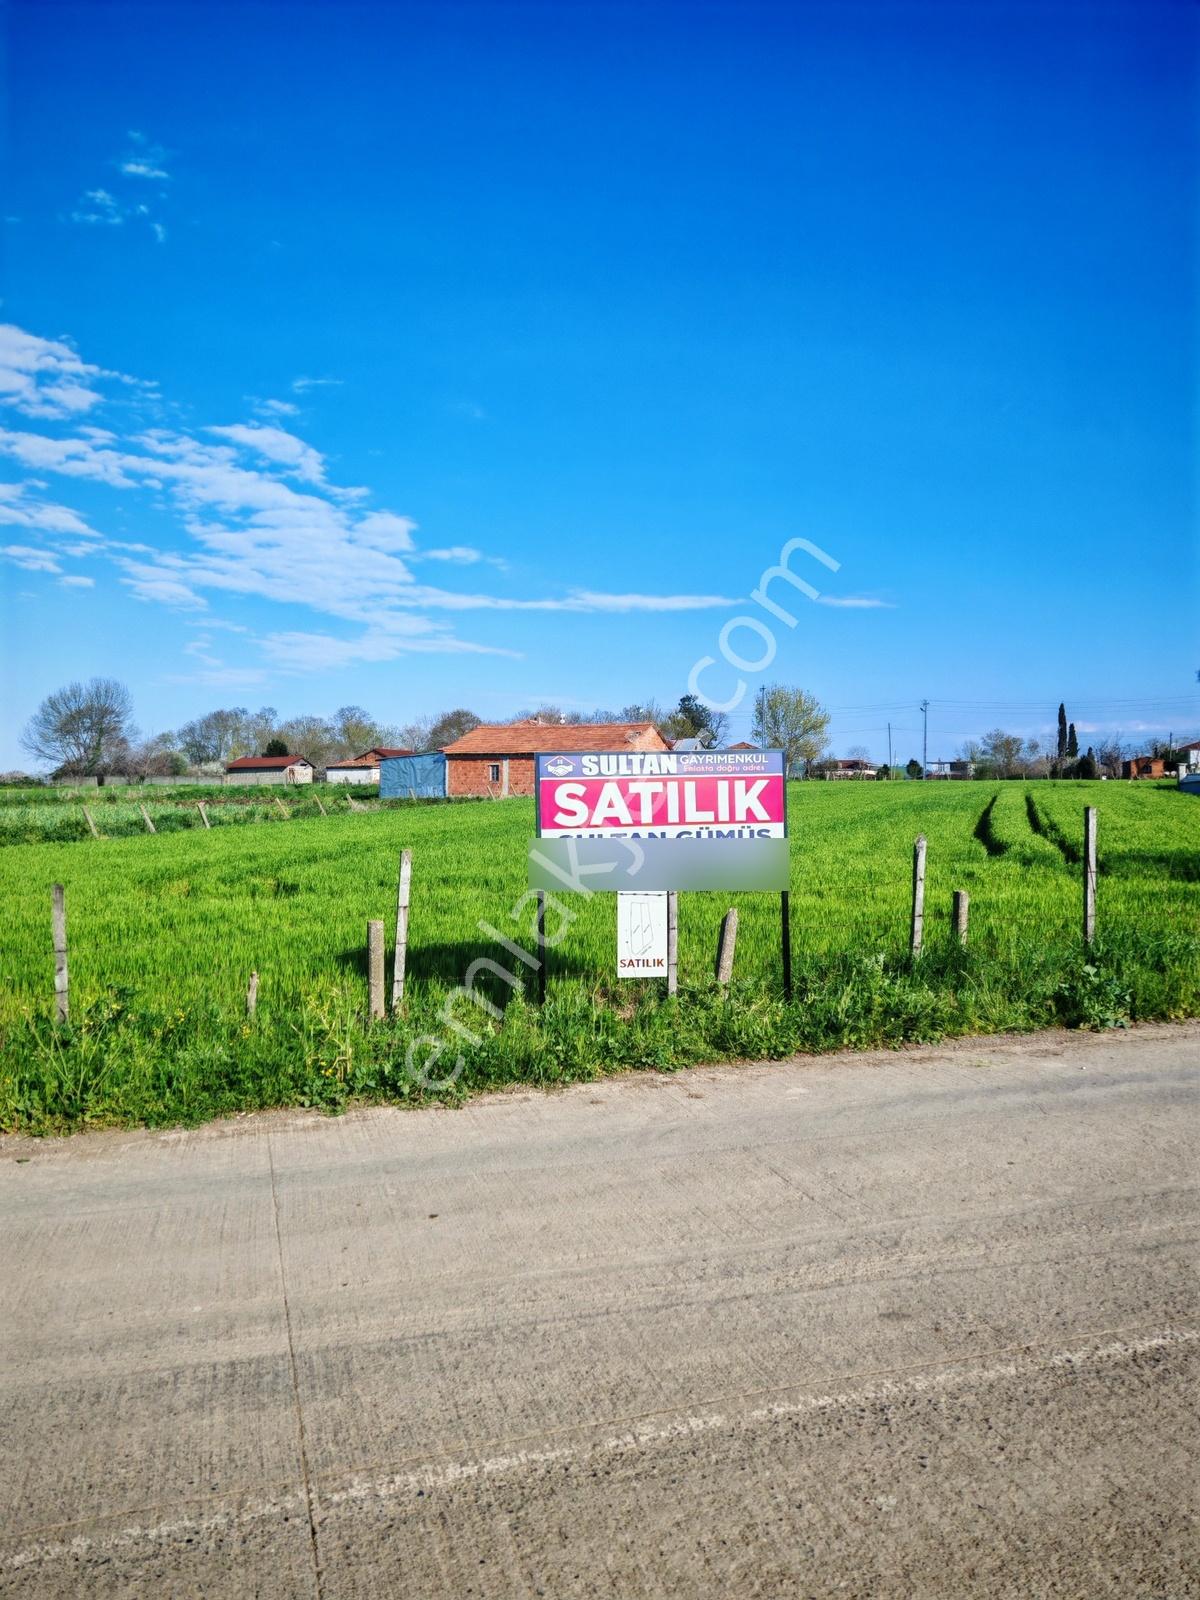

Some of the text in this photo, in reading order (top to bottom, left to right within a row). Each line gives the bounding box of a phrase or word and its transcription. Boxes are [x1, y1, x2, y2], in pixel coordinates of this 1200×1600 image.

[581, 754, 768, 775] SULTAN GAYRIMENKUL
[553, 780, 771, 827] SATILIK
[619, 958, 665, 968] SATILIK
